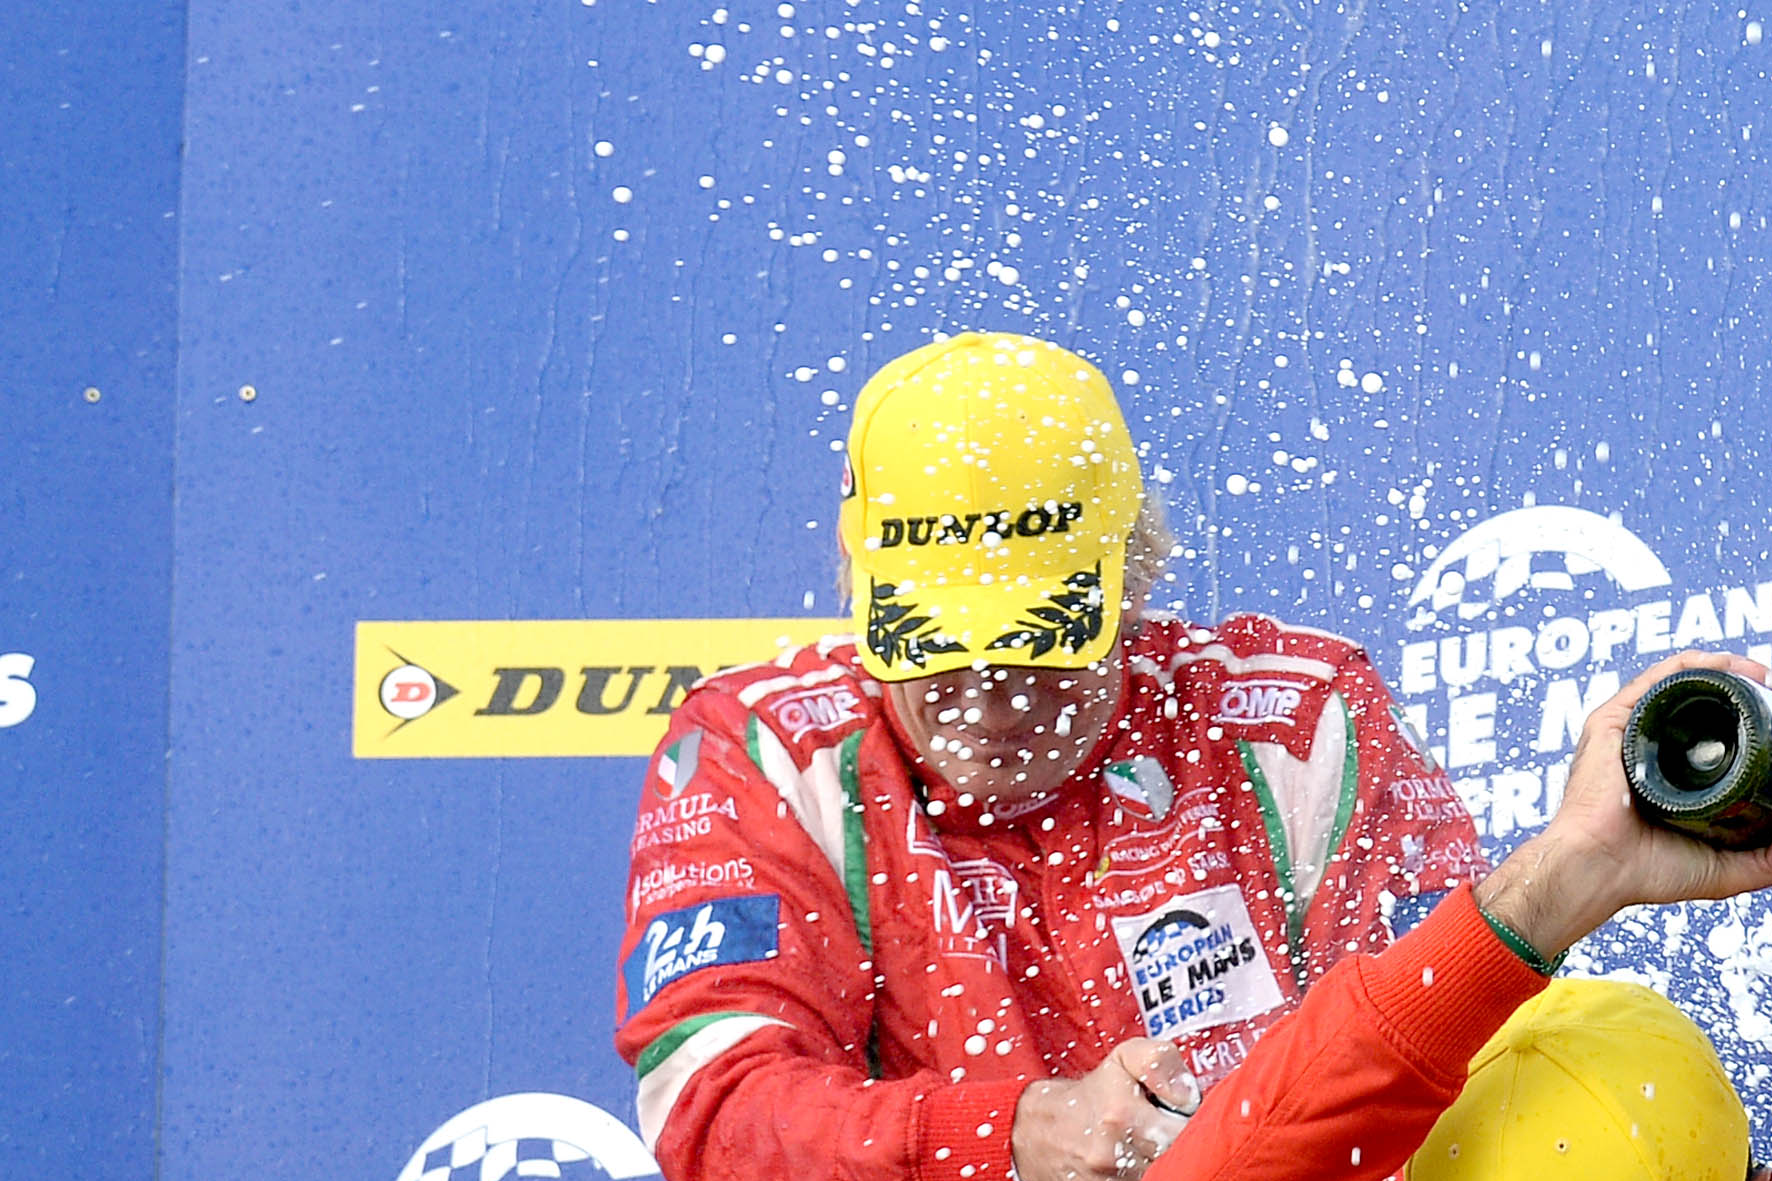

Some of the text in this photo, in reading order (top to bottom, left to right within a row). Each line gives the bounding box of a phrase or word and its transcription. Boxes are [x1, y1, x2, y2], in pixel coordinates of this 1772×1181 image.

[881, 502, 1083, 548] DUNLOP
[778, 690, 859, 732] OMP
[1219, 687, 1301, 718] OMP
[1136, 923, 1234, 985] EUROPEAN
[1187, 938, 1257, 990] MANS
[1141, 977, 1175, 1012] LE
